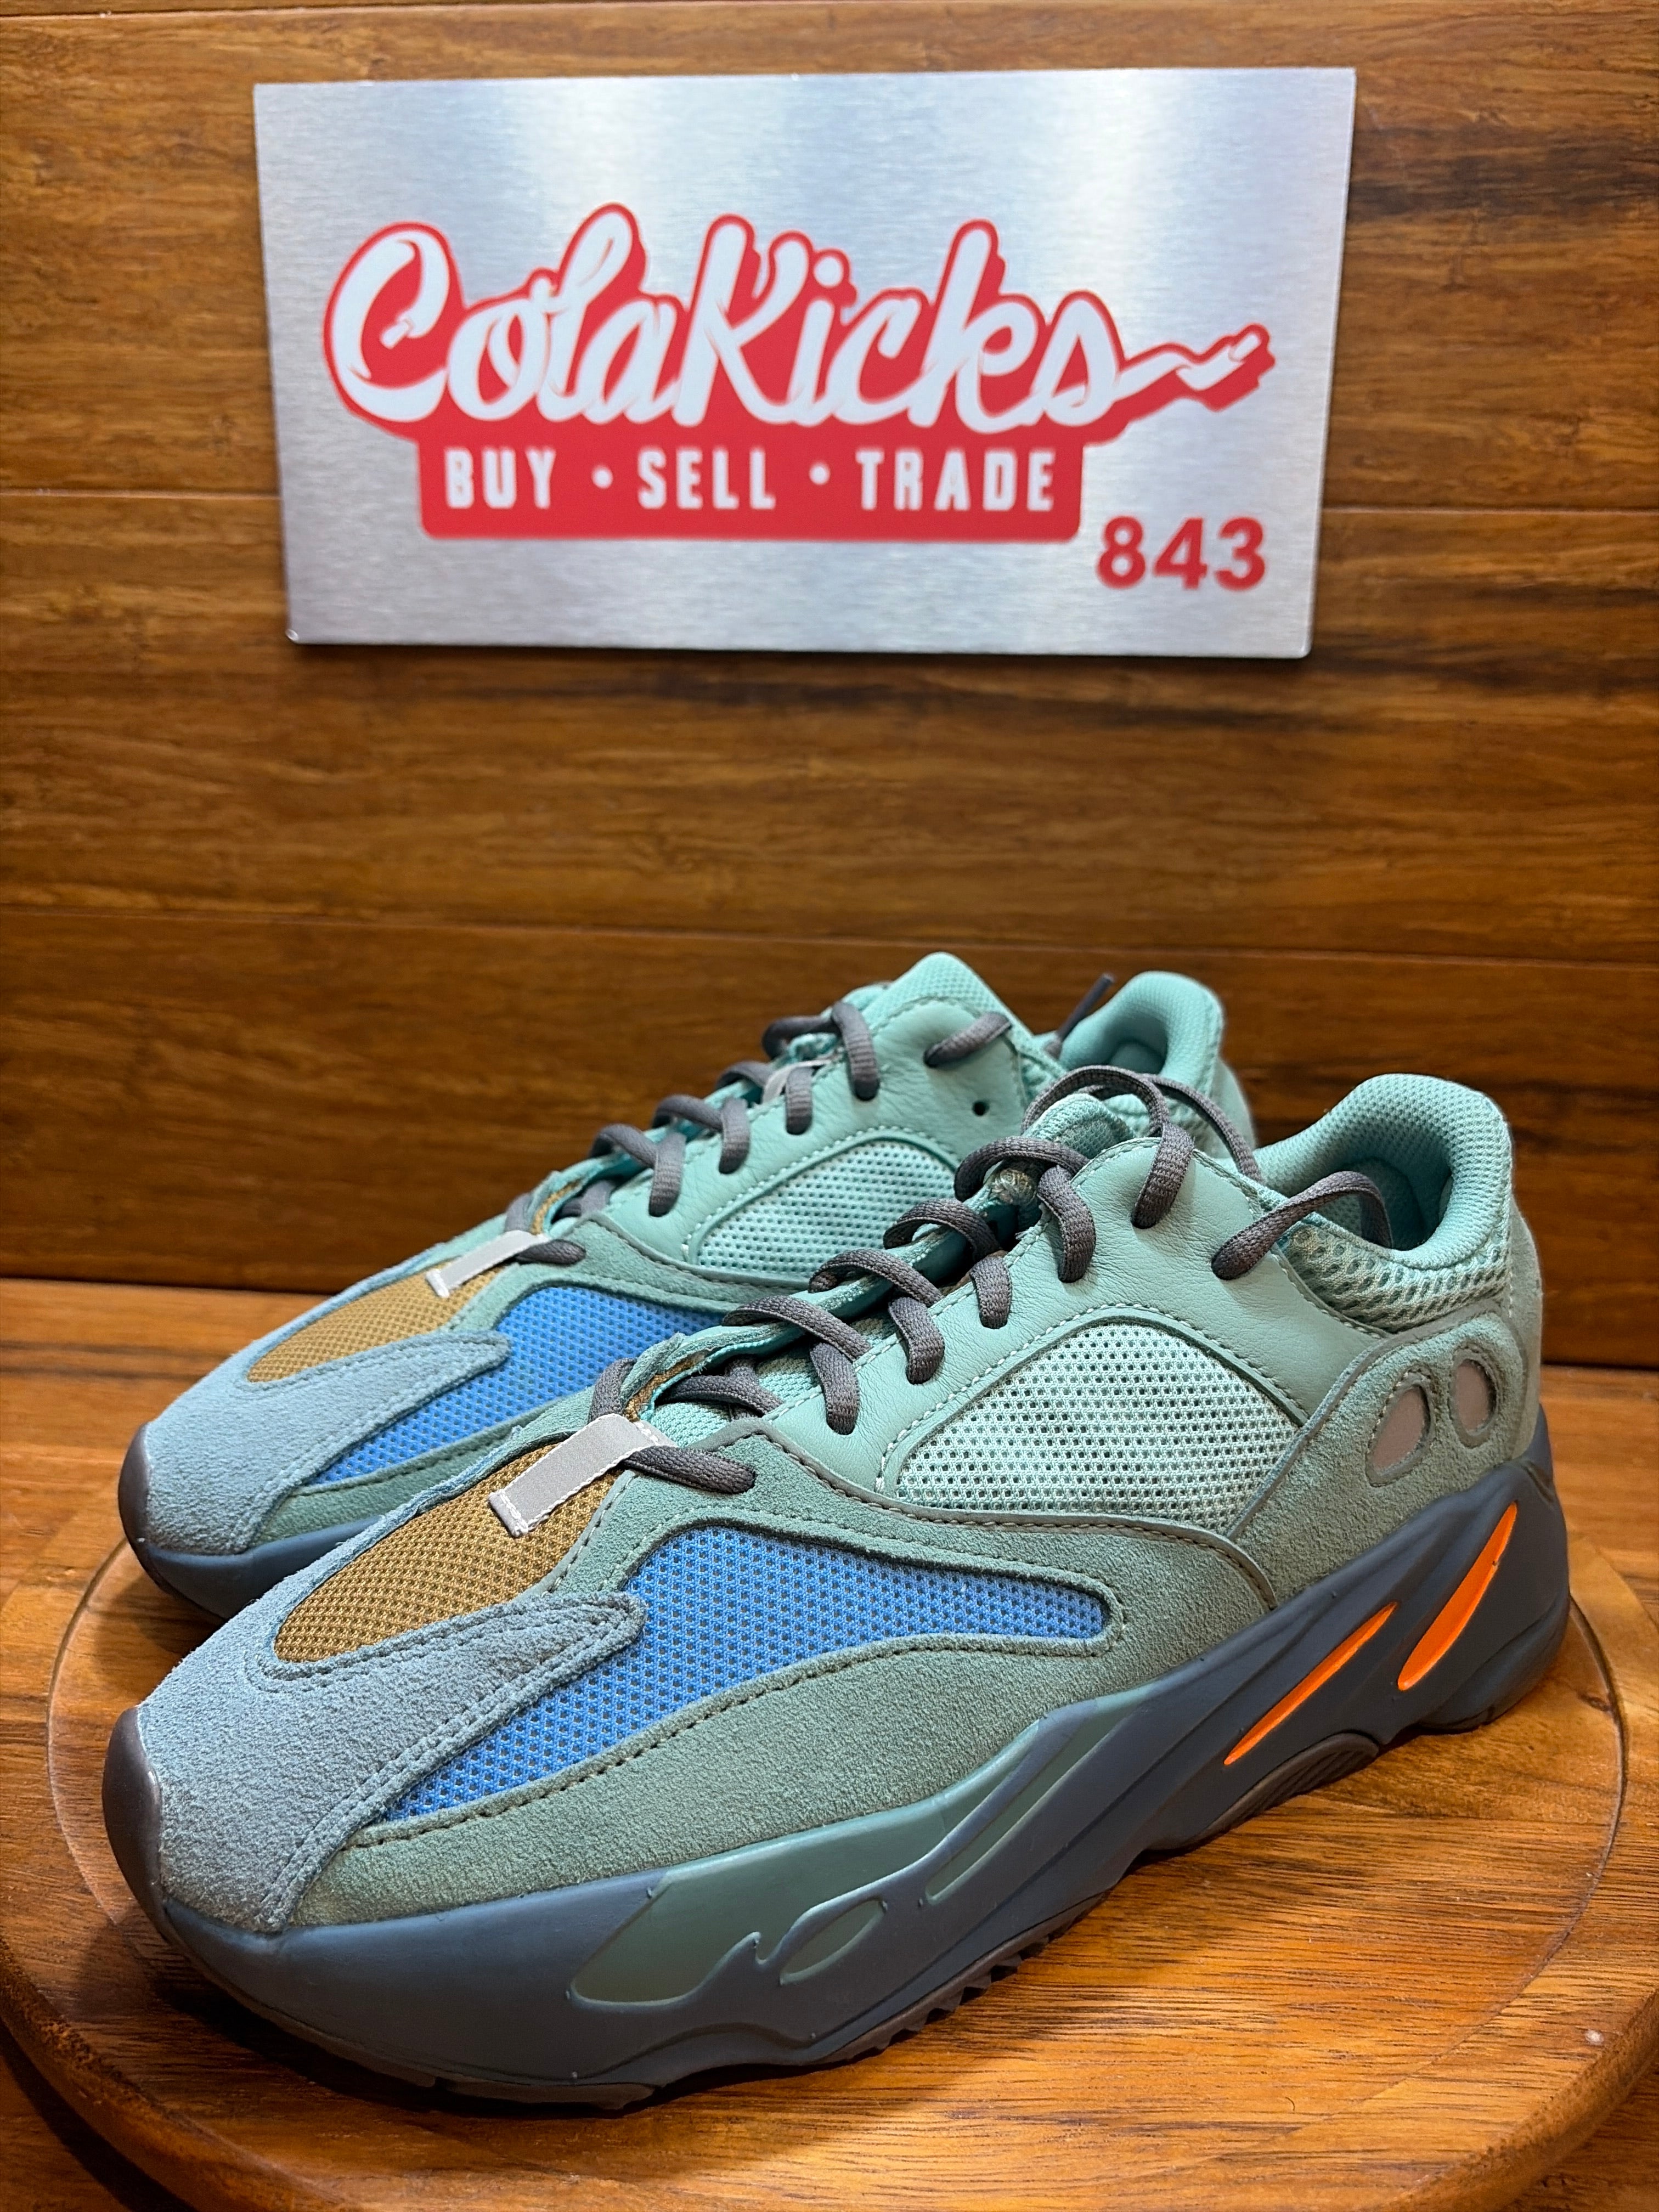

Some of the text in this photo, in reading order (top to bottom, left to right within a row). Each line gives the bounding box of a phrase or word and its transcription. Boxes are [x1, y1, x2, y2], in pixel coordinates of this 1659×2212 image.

[329, 205, 1268, 432] ColaKicks
[444, 446, 1056, 513] BUY SELL TRADE
[1097, 516, 1266, 590] 843
